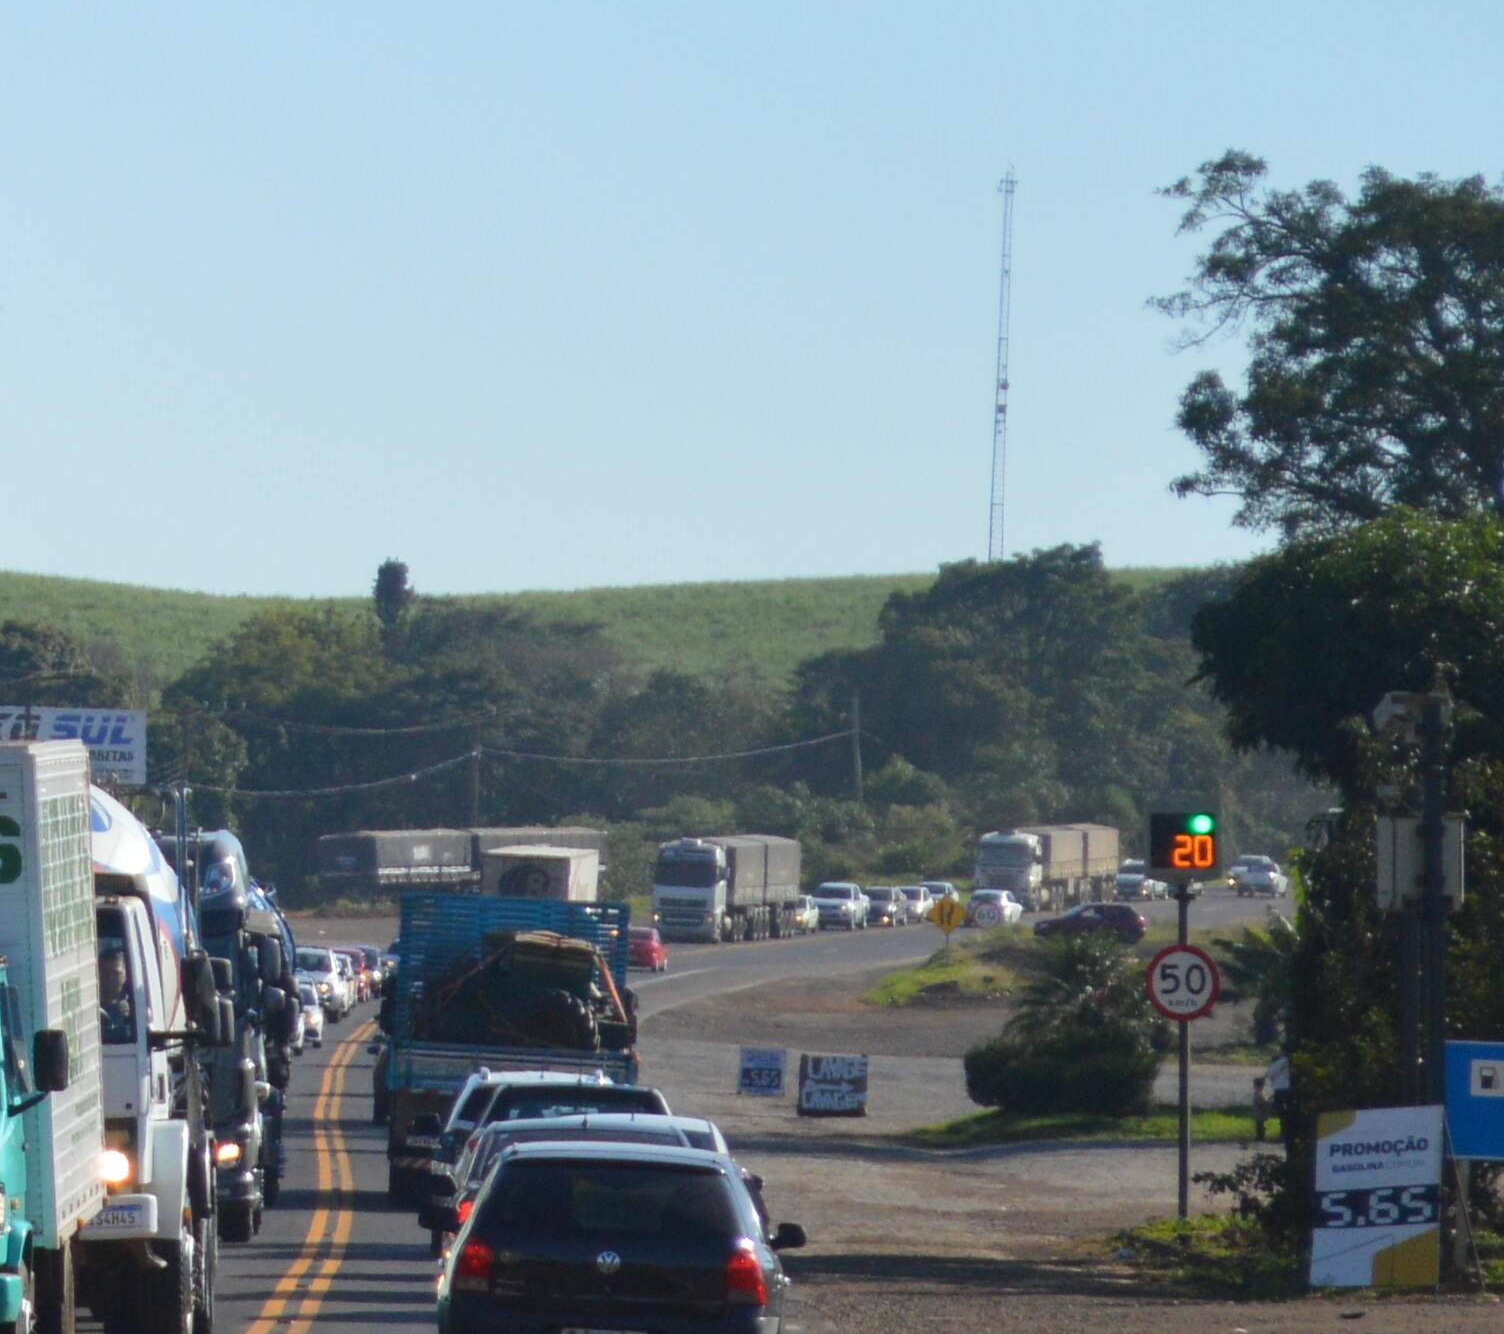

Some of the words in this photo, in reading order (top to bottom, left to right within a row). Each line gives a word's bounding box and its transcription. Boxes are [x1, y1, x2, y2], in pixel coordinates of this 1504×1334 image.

[50, 714, 134, 744] SUL
[1172, 833, 1214, 867] 20
[1160, 964, 1206, 995] 50
[1329, 1135, 1428, 1156] PROMOÇÃO
[1321, 1187, 1432, 1226] 5.65
